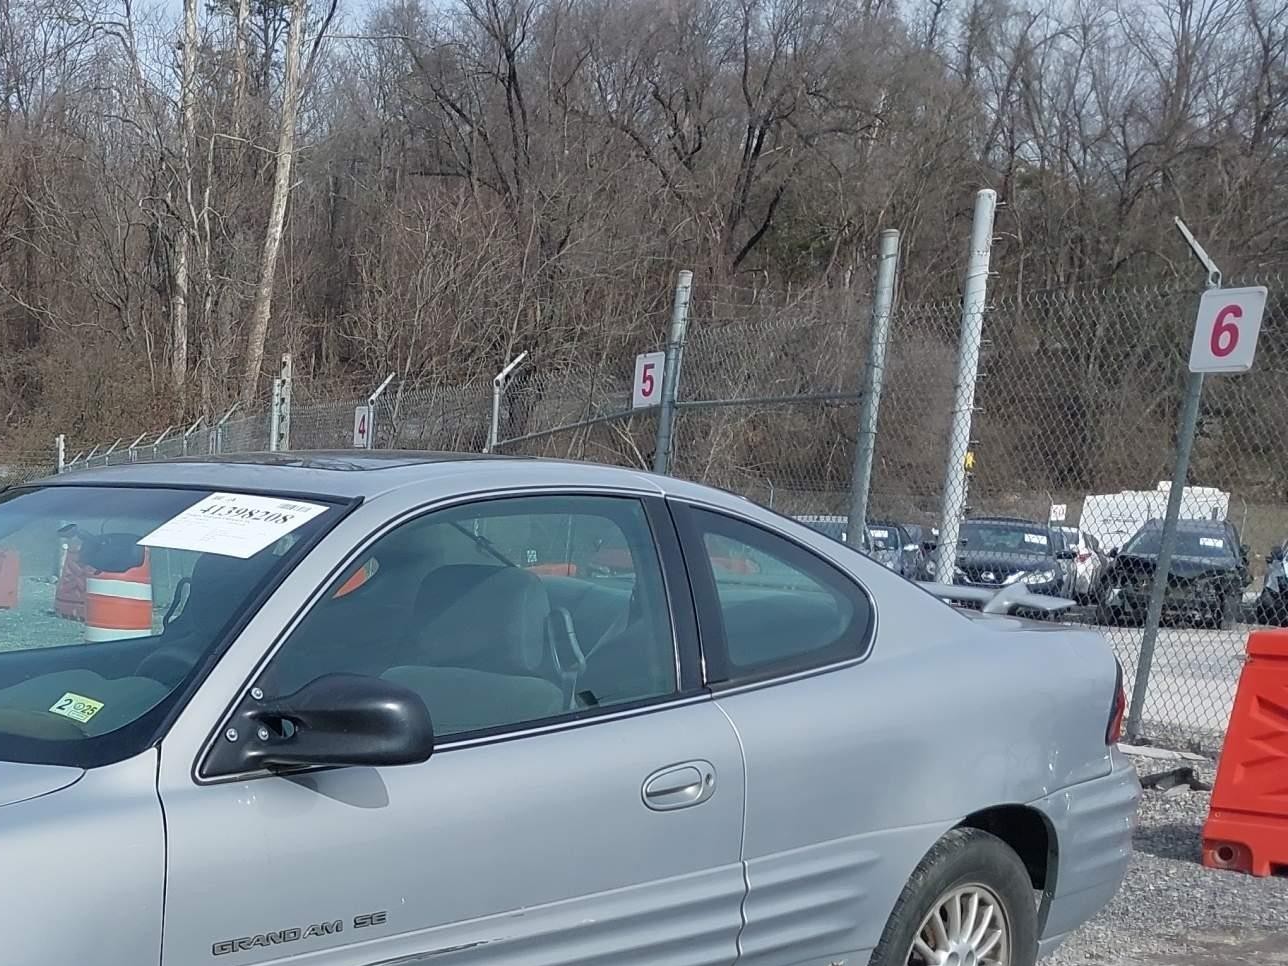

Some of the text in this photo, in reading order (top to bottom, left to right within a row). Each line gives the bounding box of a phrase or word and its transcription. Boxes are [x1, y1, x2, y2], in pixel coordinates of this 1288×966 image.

[1211, 304, 1243, 357] 6
[641, 363, 655, 397] 5
[358, 413, 366, 440] 4
[200, 504, 294, 524] 41398208
[56, 698, 98, 716] 2 25
[212, 911, 388, 956] GRAND AM SE
